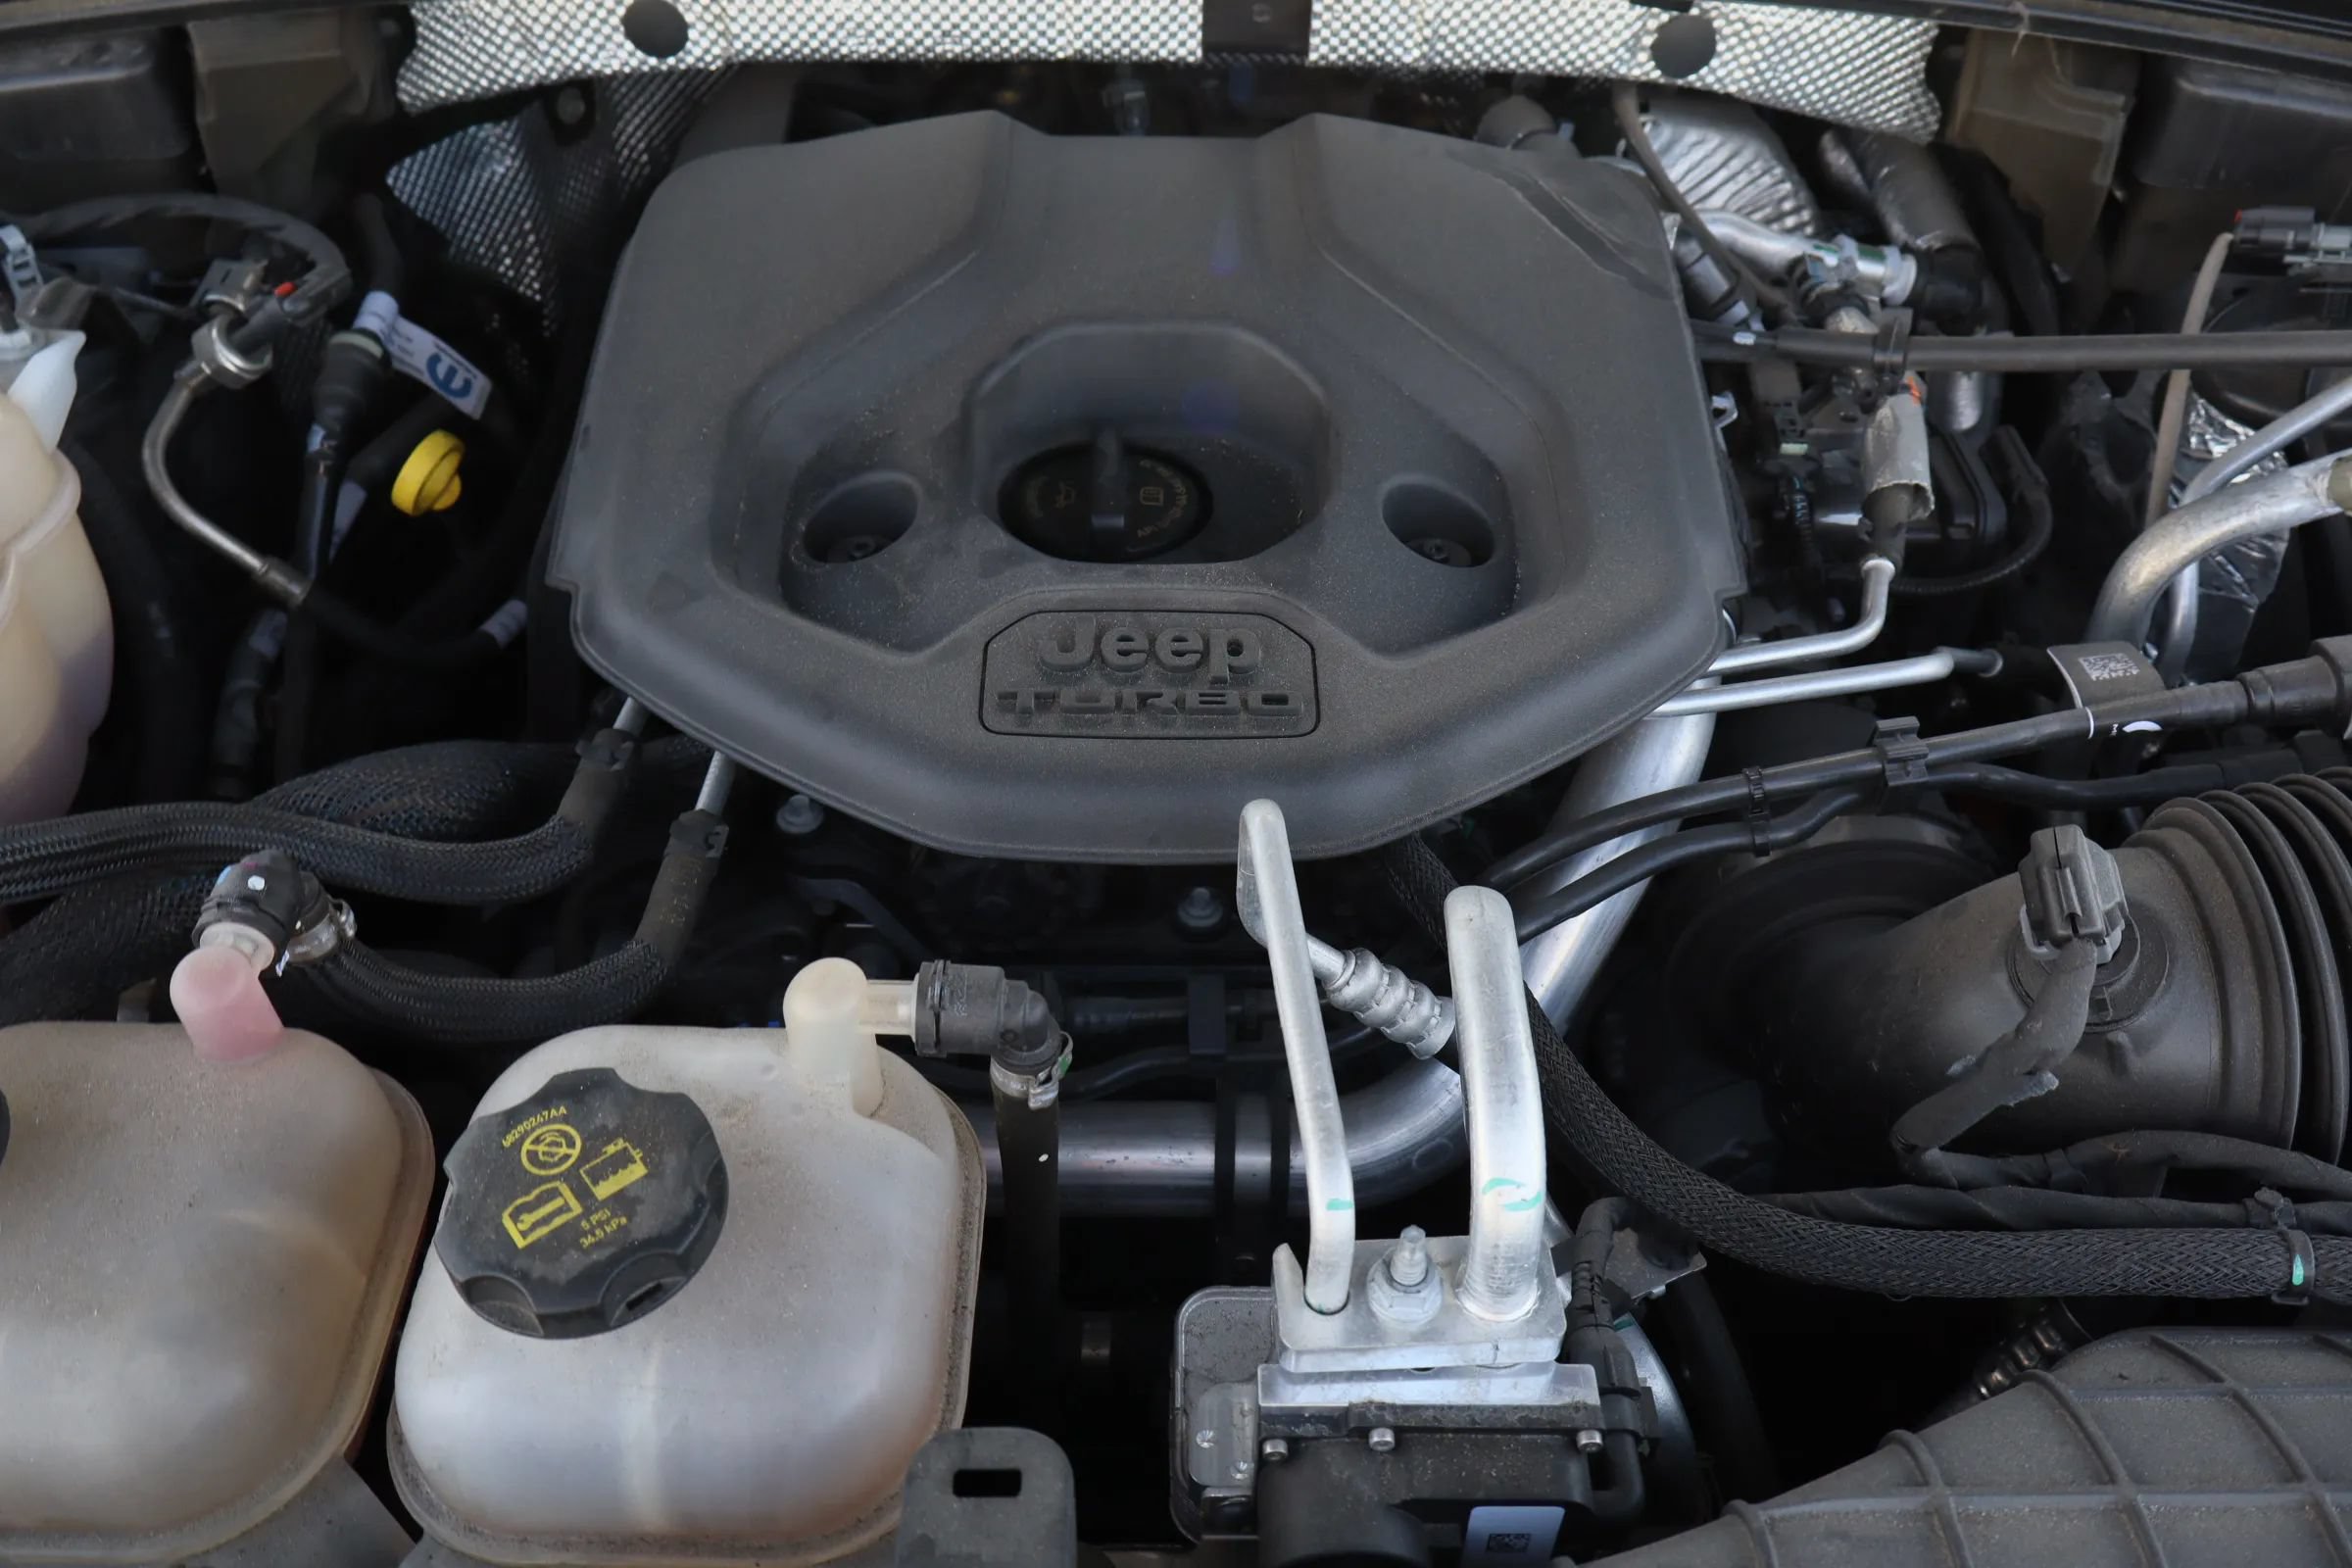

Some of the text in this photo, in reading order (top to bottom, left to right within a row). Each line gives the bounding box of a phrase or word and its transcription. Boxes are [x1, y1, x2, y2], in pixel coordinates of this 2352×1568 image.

[1038, 614, 1261, 684] Jeep
[996, 689, 1305, 716] TURBO
[590, 1207, 612, 1225] PSI
[604, 1216, 627, 1233] kPa
